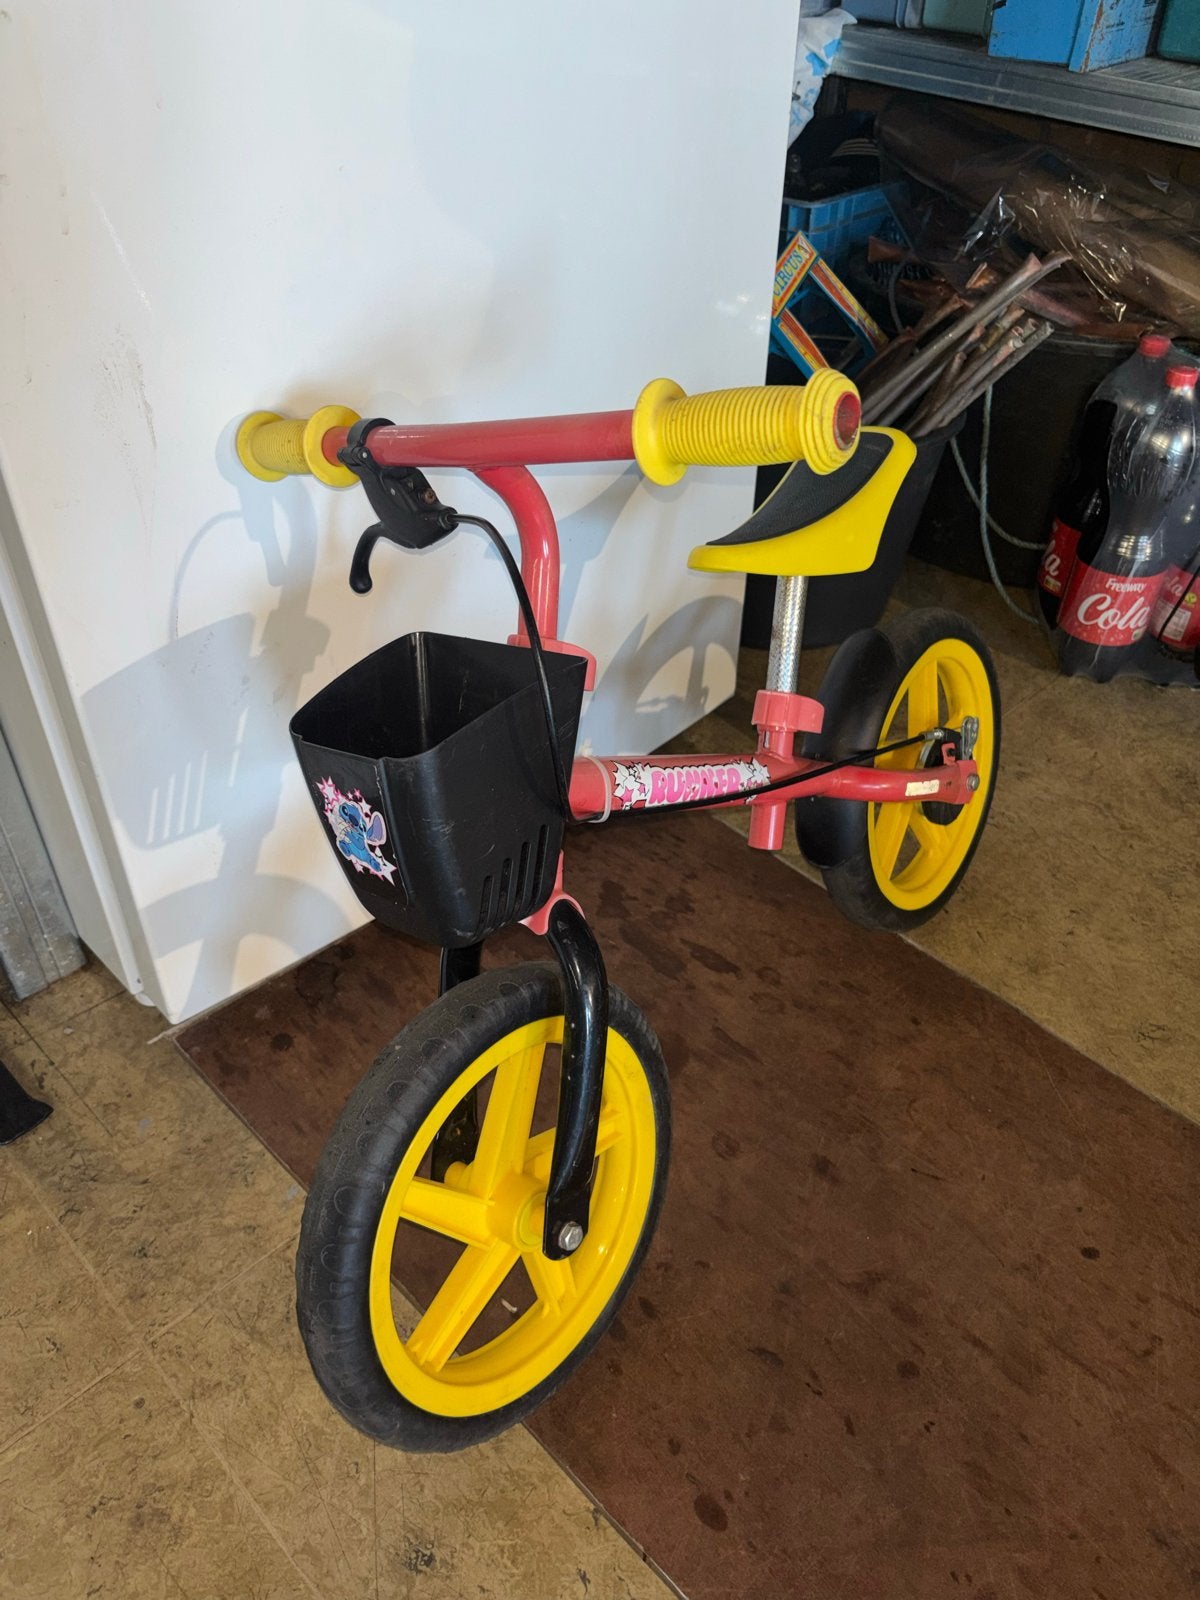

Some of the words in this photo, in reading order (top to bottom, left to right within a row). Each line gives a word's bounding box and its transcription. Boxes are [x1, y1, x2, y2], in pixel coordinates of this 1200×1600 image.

[1105, 578, 1146, 593] Freeway
[1077, 593, 1150, 630] Cola
[650, 768, 742, 805] RUNNER
